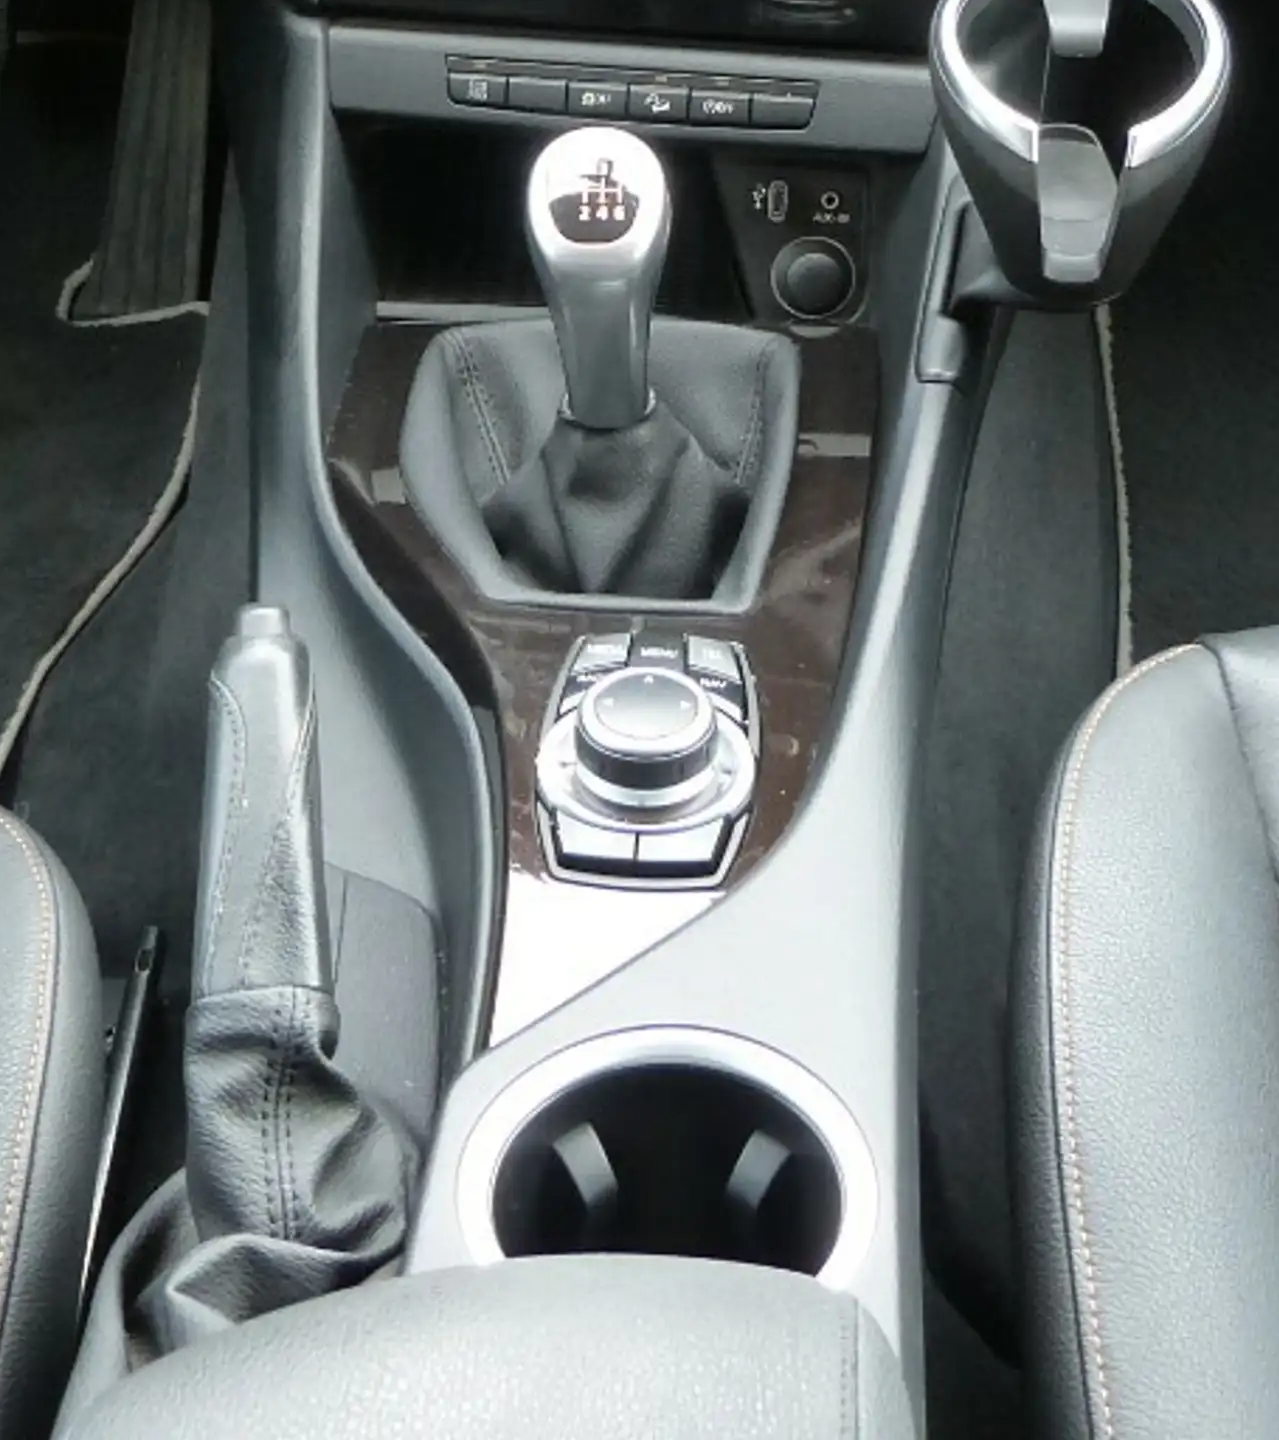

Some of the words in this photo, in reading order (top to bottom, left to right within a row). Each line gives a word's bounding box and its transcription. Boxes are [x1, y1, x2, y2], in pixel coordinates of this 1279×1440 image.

[579, 204, 591, 221] 2
[595, 204, 609, 221] 4
[640, 646, 678, 659] MENU
